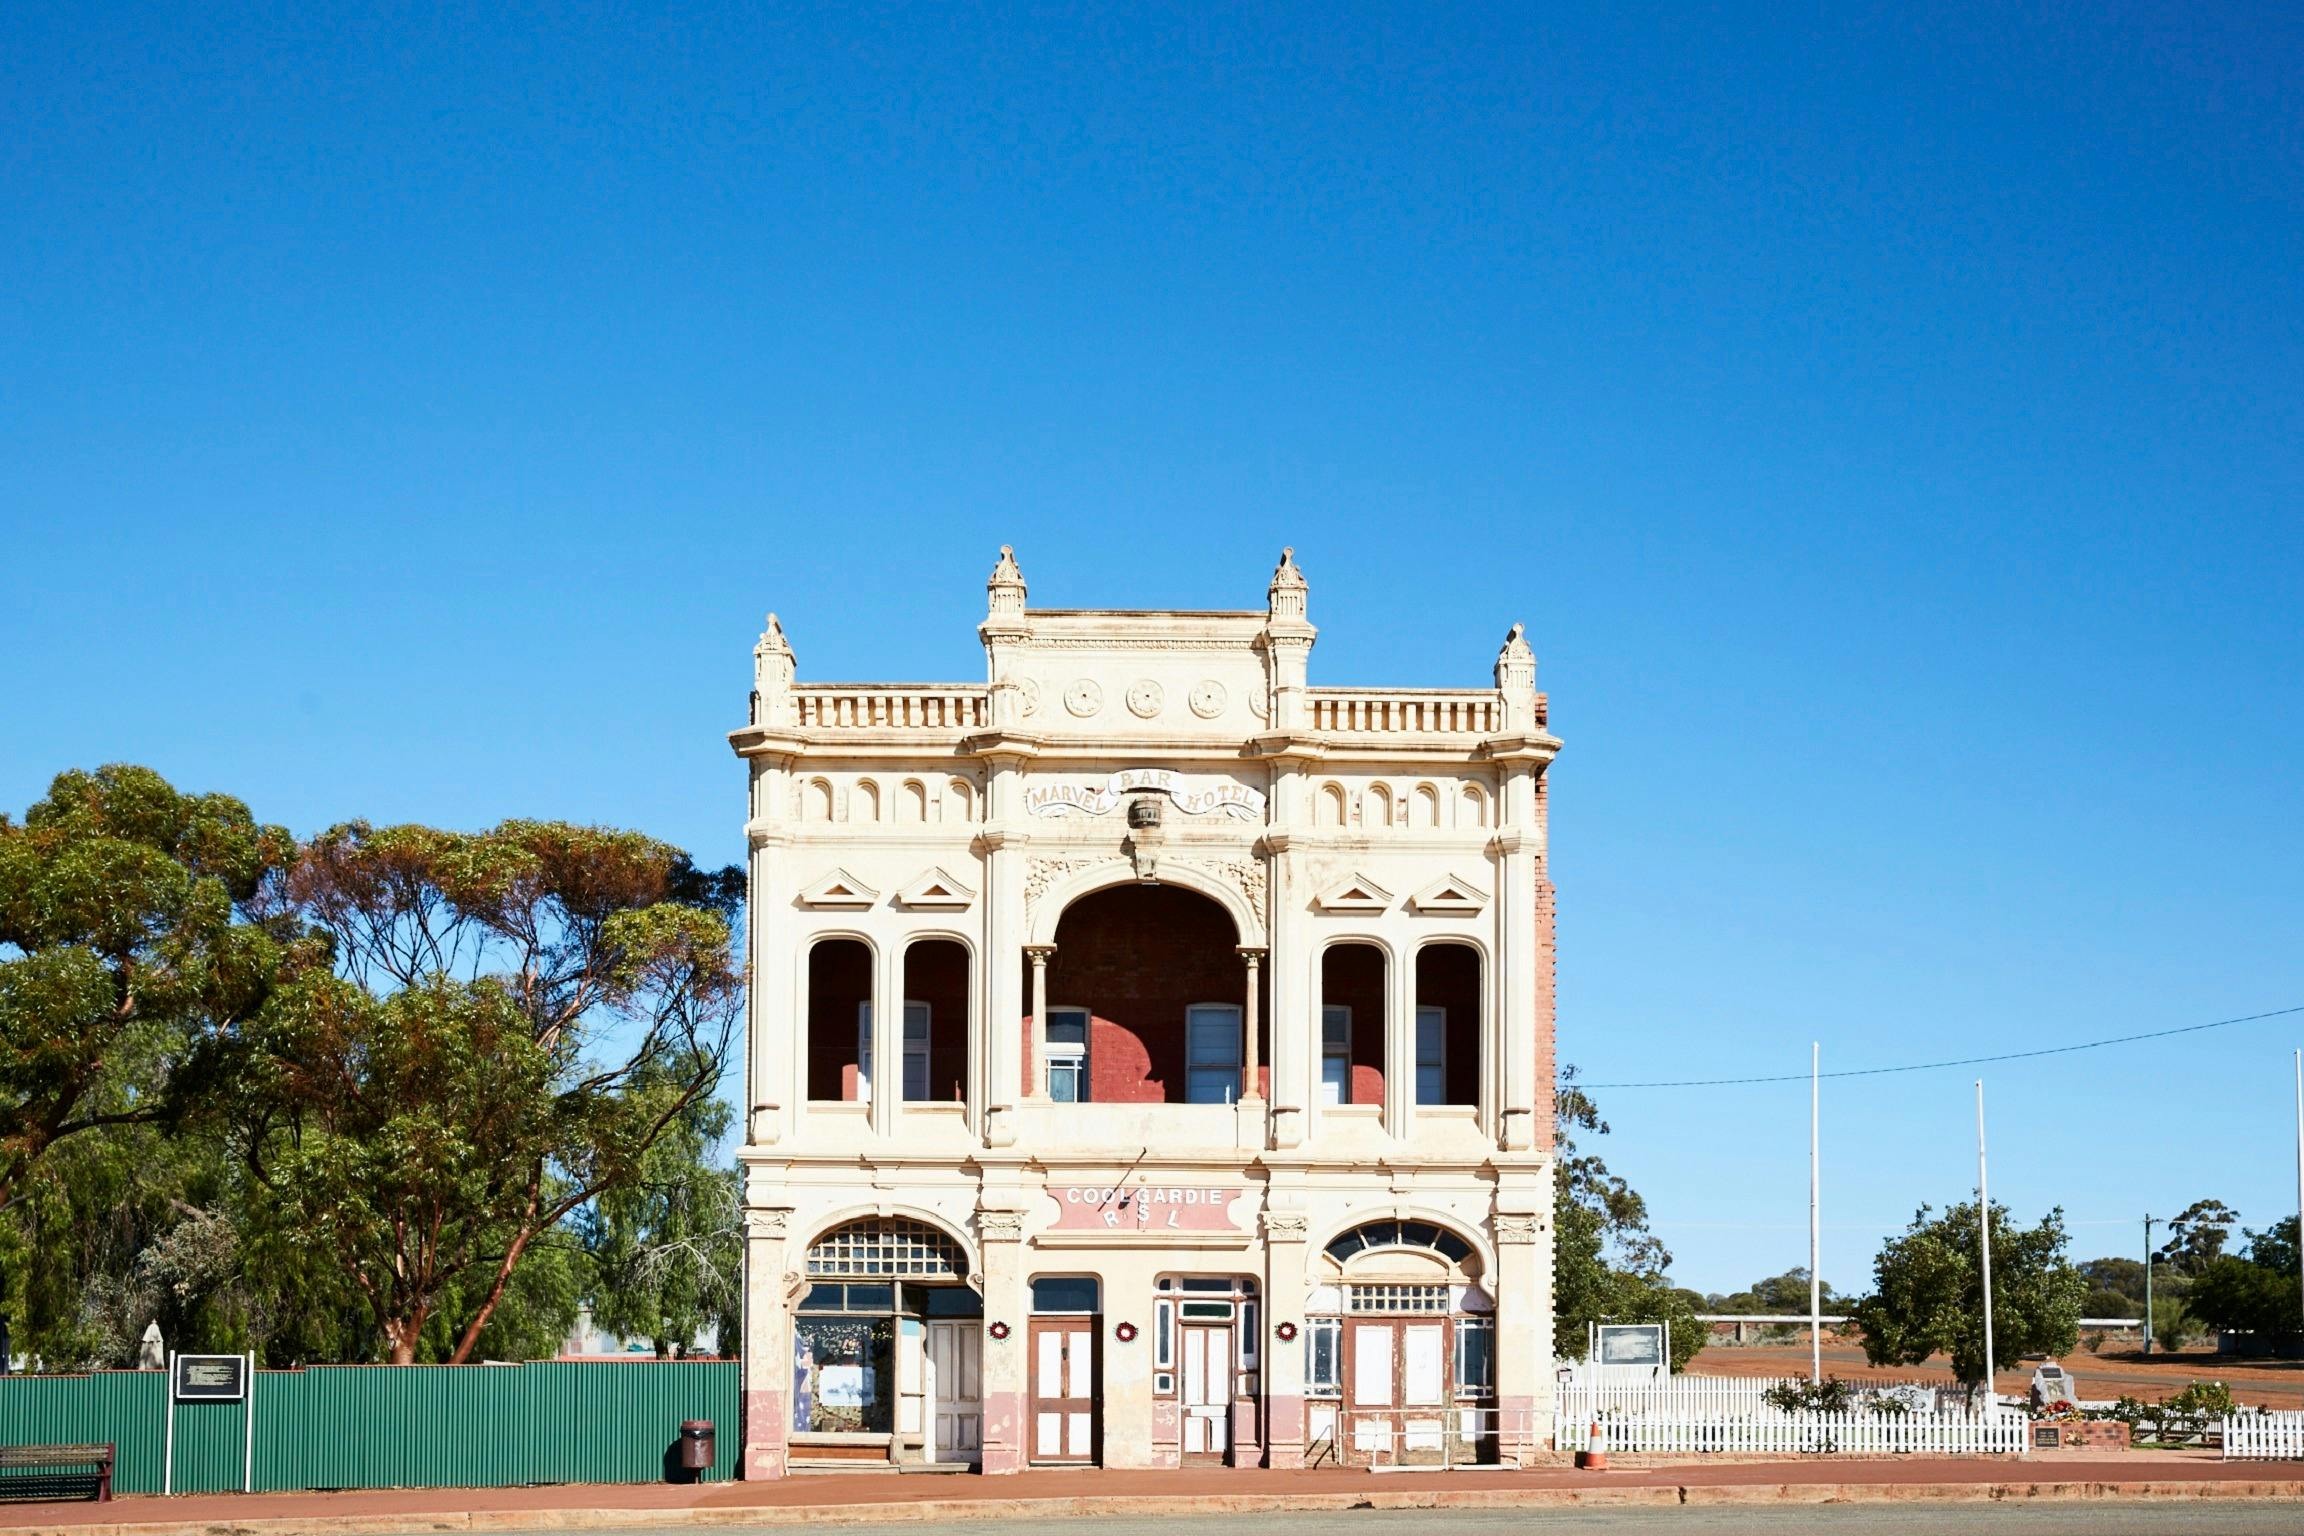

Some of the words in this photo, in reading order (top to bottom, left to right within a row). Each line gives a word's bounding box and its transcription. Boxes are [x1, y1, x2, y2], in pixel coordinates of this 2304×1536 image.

[1032, 784, 1107, 812] MARVEL
[1120, 771, 1170, 787] BAR
[1187, 785, 1255, 811] HOTEL
